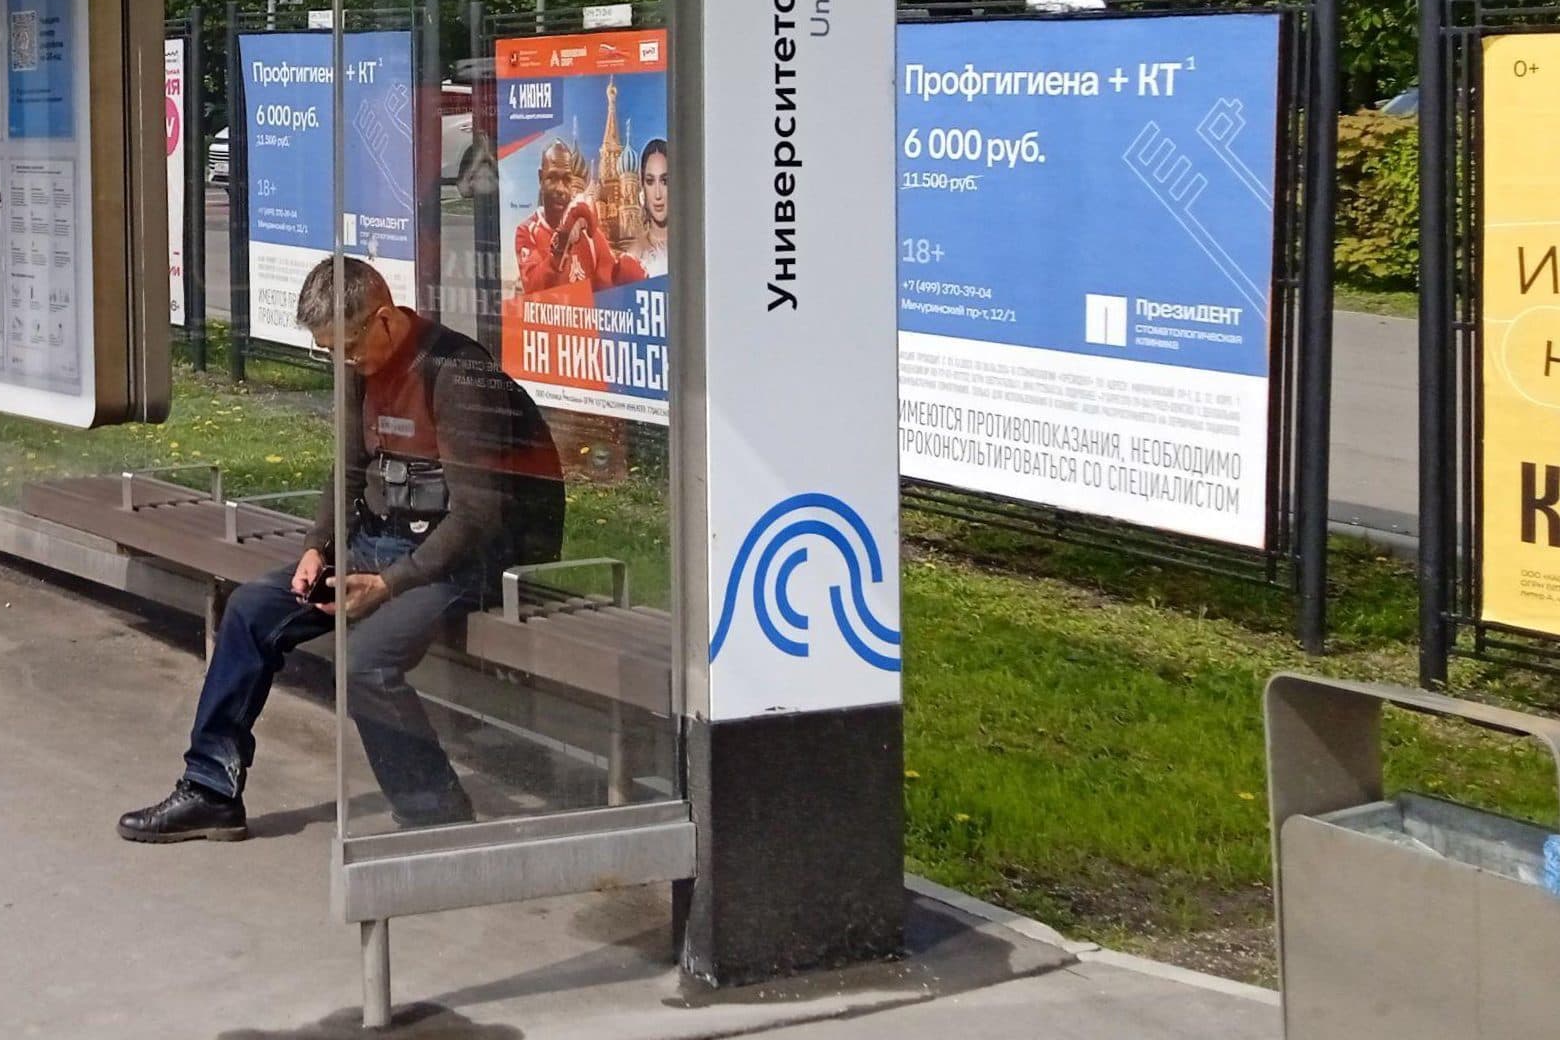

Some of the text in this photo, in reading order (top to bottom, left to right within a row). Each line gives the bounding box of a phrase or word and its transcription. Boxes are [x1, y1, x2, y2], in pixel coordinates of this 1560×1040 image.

[253, 61, 334, 87] Профгигиен
[1513, 60, 1539, 77] 0+
[905, 63, 1099, 101] Профгигиена
[1108, 68, 1129, 92] +
[509, 83, 552, 109] 4 ИЮНЯ
[292, 106, 320, 132] руб.
[987, 130, 1046, 168] руб.
[257, 179, 277, 197] 18+
[950, 175, 978, 192] руб.
[902, 238, 945, 264] 18+
[903, 280, 992, 299] +7 (499) 370-39-04
[523, 301, 634, 335] ЛЕГКОАТЛЕТИЧЕСКИЙ
[901, 298, 965, 316] Мичуринский
[991, 309, 1017, 322] 12/1
[1135, 298, 1243, 326] ПрезиДЕНТ
[1135, 324, 1243, 345] стоматологическая
[523, 330, 550, 374] НА
[967, 409, 1126, 462] ПРОТИВОПОКАЗАНИЯ,
[1131, 436, 1242, 480] НЕОБХОДИМО
[899, 427, 1241, 514] ПРОКОНСУЛЬТИРОВАТЬСЯ СО СПЕЦИАЛИСТОМ
